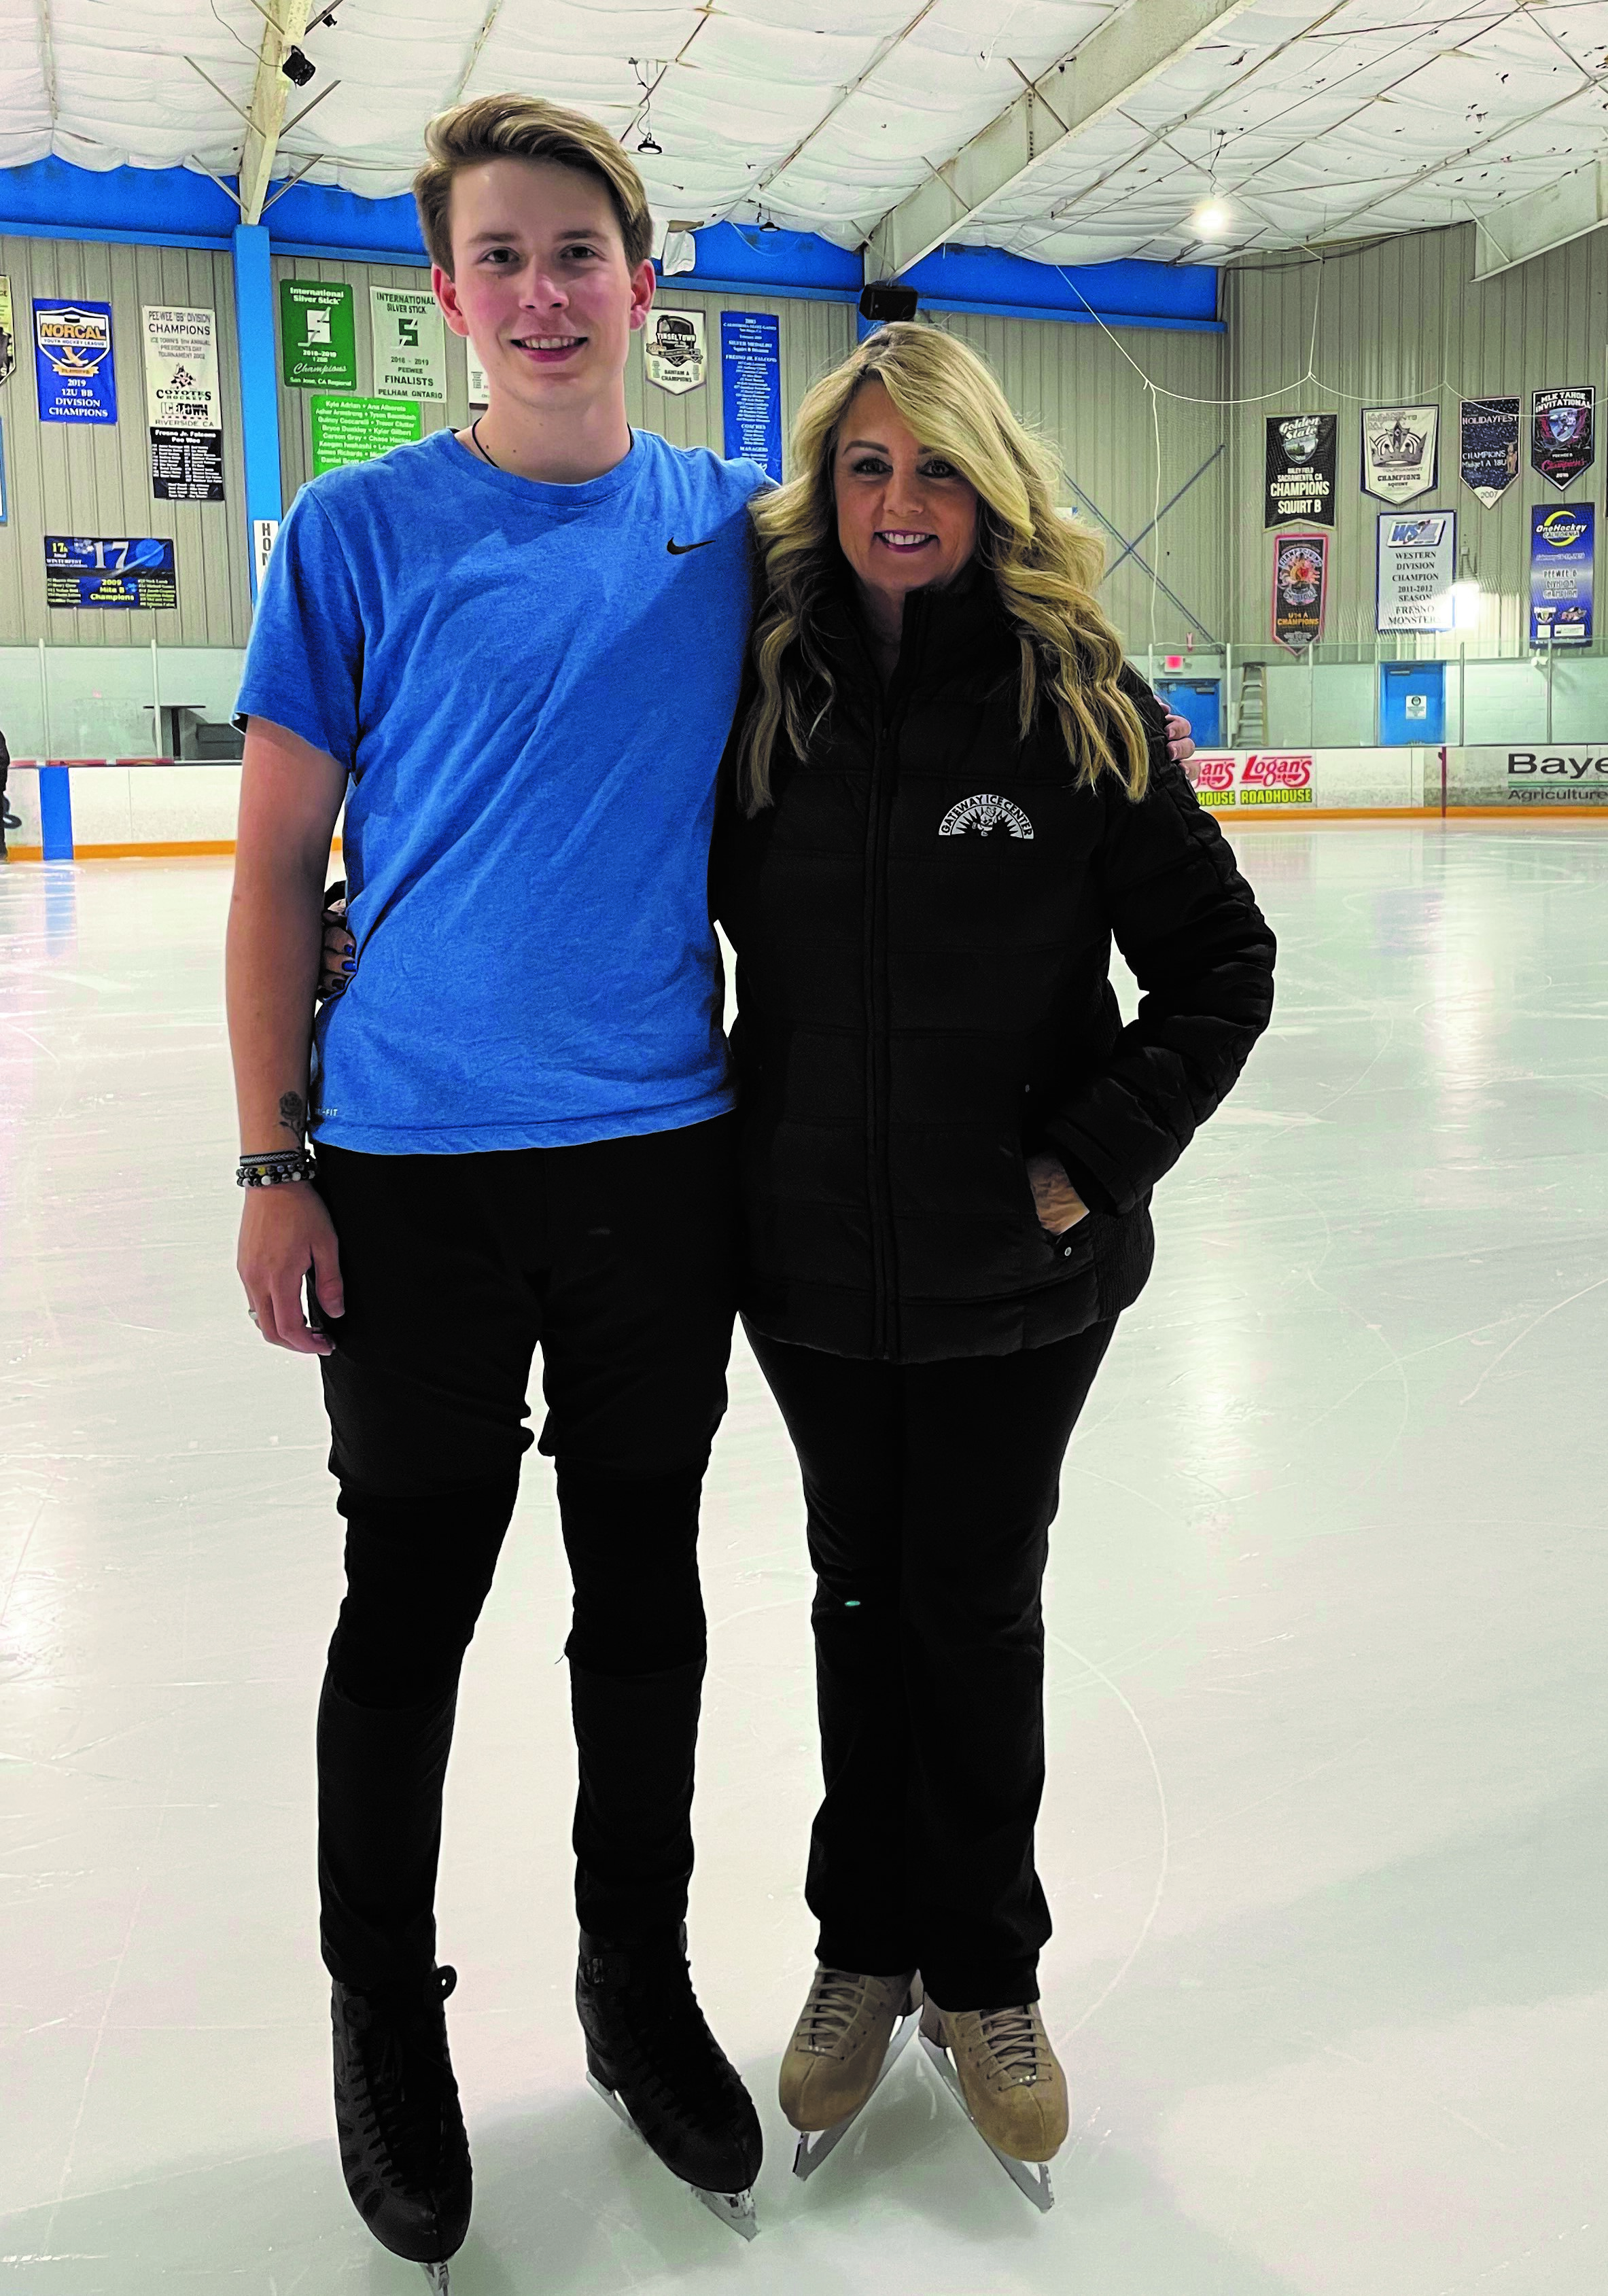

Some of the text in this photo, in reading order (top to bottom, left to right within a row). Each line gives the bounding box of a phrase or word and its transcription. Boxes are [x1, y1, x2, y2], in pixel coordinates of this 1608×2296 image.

[290, 287, 344, 298] International
[294, 295, 317, 303] Silver
[377, 292, 436, 305] INTERNATIONAL
[387, 303, 427, 314] SILVER STICK
[187, 313, 211, 323] DIVISION
[41, 322, 106, 340] NORCAL
[148, 323, 211, 335] CHAMPIONS
[294, 363, 347, 374] Champions
[67, 378, 86, 387] 2019
[385, 374, 434, 386] FINALISTS
[156, 389, 211, 401] COYOTES
[378, 389, 442, 399] PELHAM ONTARIO
[1541, 393, 1558, 404] MLK
[55, 398, 101, 407] DIVISION
[1535, 398, 1592, 413] INVITATIONAL
[48, 407, 109, 417] CHAMPIONS
[1462, 414, 1518, 425] HOLIDAYFEST
[1279, 417, 1320, 434] Golden
[1285, 425, 1317, 441] State
[1462, 450, 1506, 459] CHAMPIONS
[1270, 481, 1330, 497] CHAMPIONS
[1278, 499, 1322, 514] SQUIRT B
[1536, 524, 1587, 533] OneHockey
[94, 541, 129, 569] 17
[1395, 551, 1436, 559] WESTERN
[1397, 561, 1435, 570] DIVISION
[1392, 573, 1439, 582] CHAMPION
[1398, 585, 1433, 593] 2011-2012
[1399, 594, 1432, 602] SEASON
[1396, 605, 1435, 614] FRESNO
[1388, 616, 1440, 625] MONSTER
[1241, 755, 1312, 788] Logan's
[1240, 788, 1312, 805] ROADHOUSE
[1508, 788, 1608, 802] Agriculture
[941, 795, 1032, 836] GATEWAY ICE CENTER
